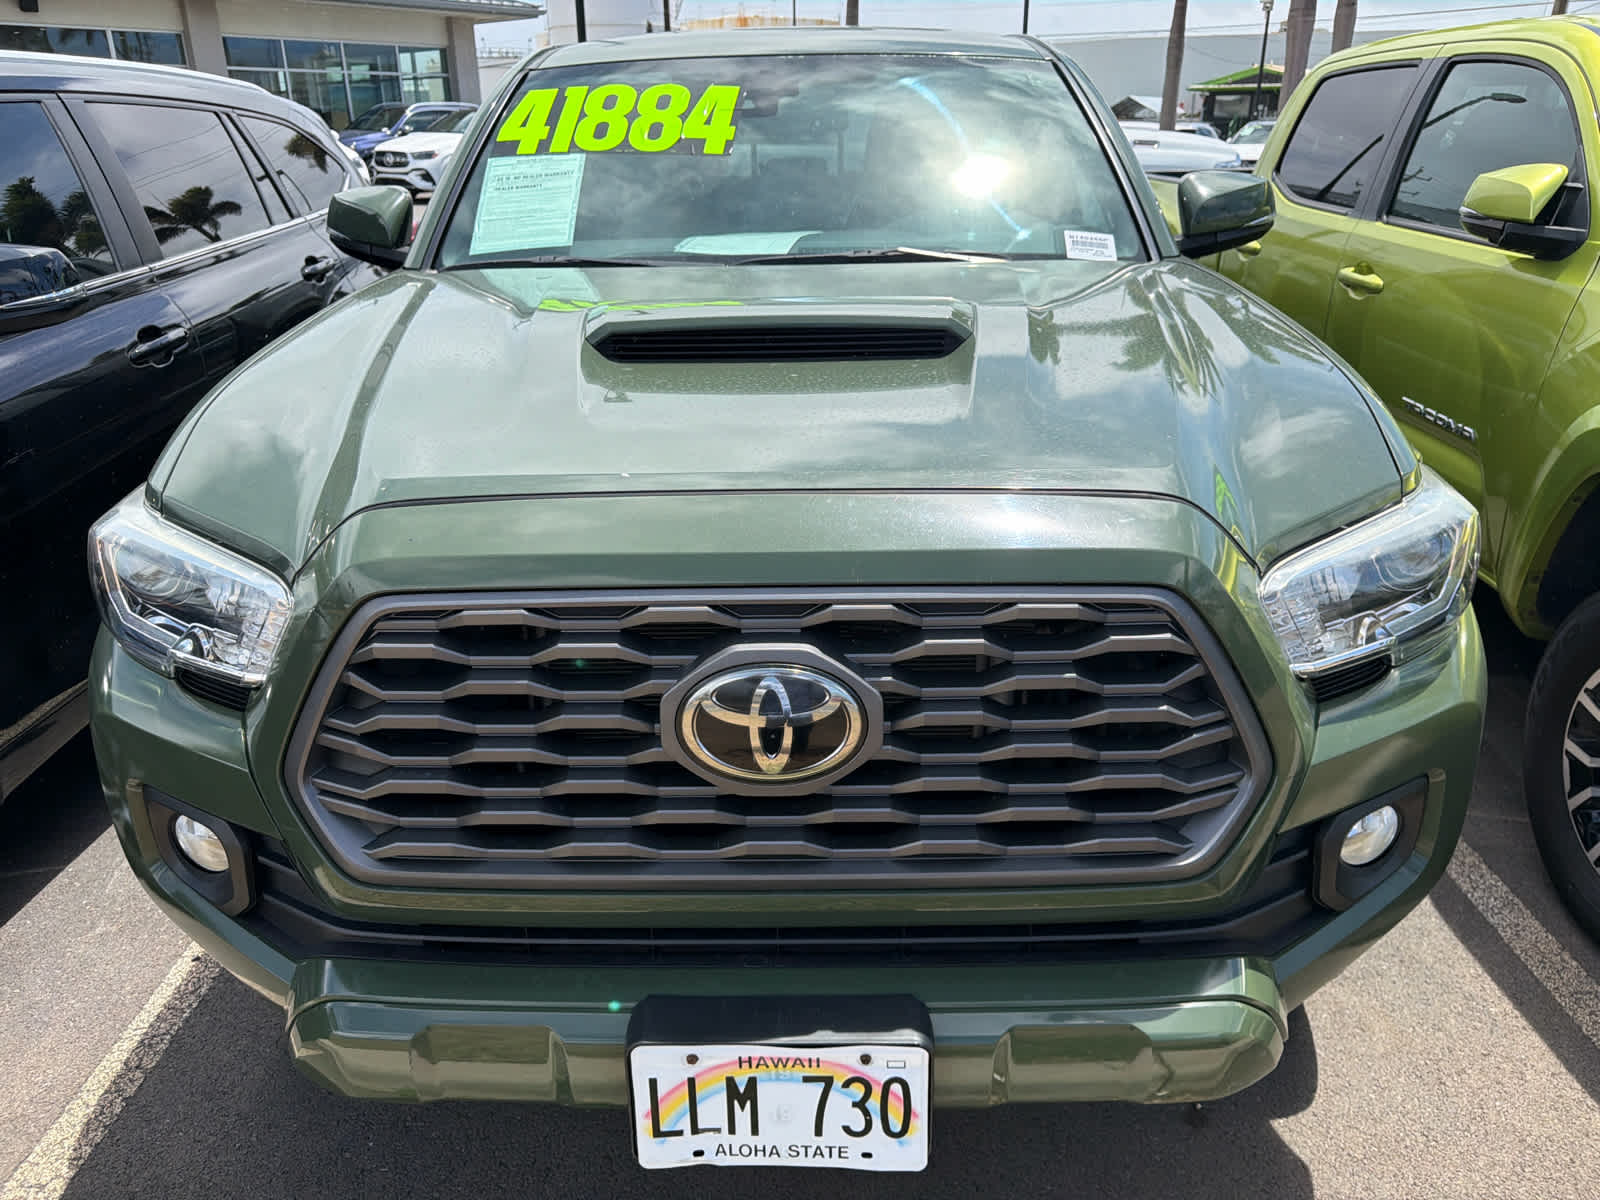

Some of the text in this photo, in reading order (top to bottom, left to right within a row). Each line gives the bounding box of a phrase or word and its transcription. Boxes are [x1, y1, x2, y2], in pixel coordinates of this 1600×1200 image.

[496, 83, 741, 155] 41884
[1401, 396, 1475, 442] TACOMA
[738, 1056, 821, 1069] HAWAII
[648, 1075, 912, 1139] LLM 730
[715, 1143, 849, 1159] ALOHA STATE
